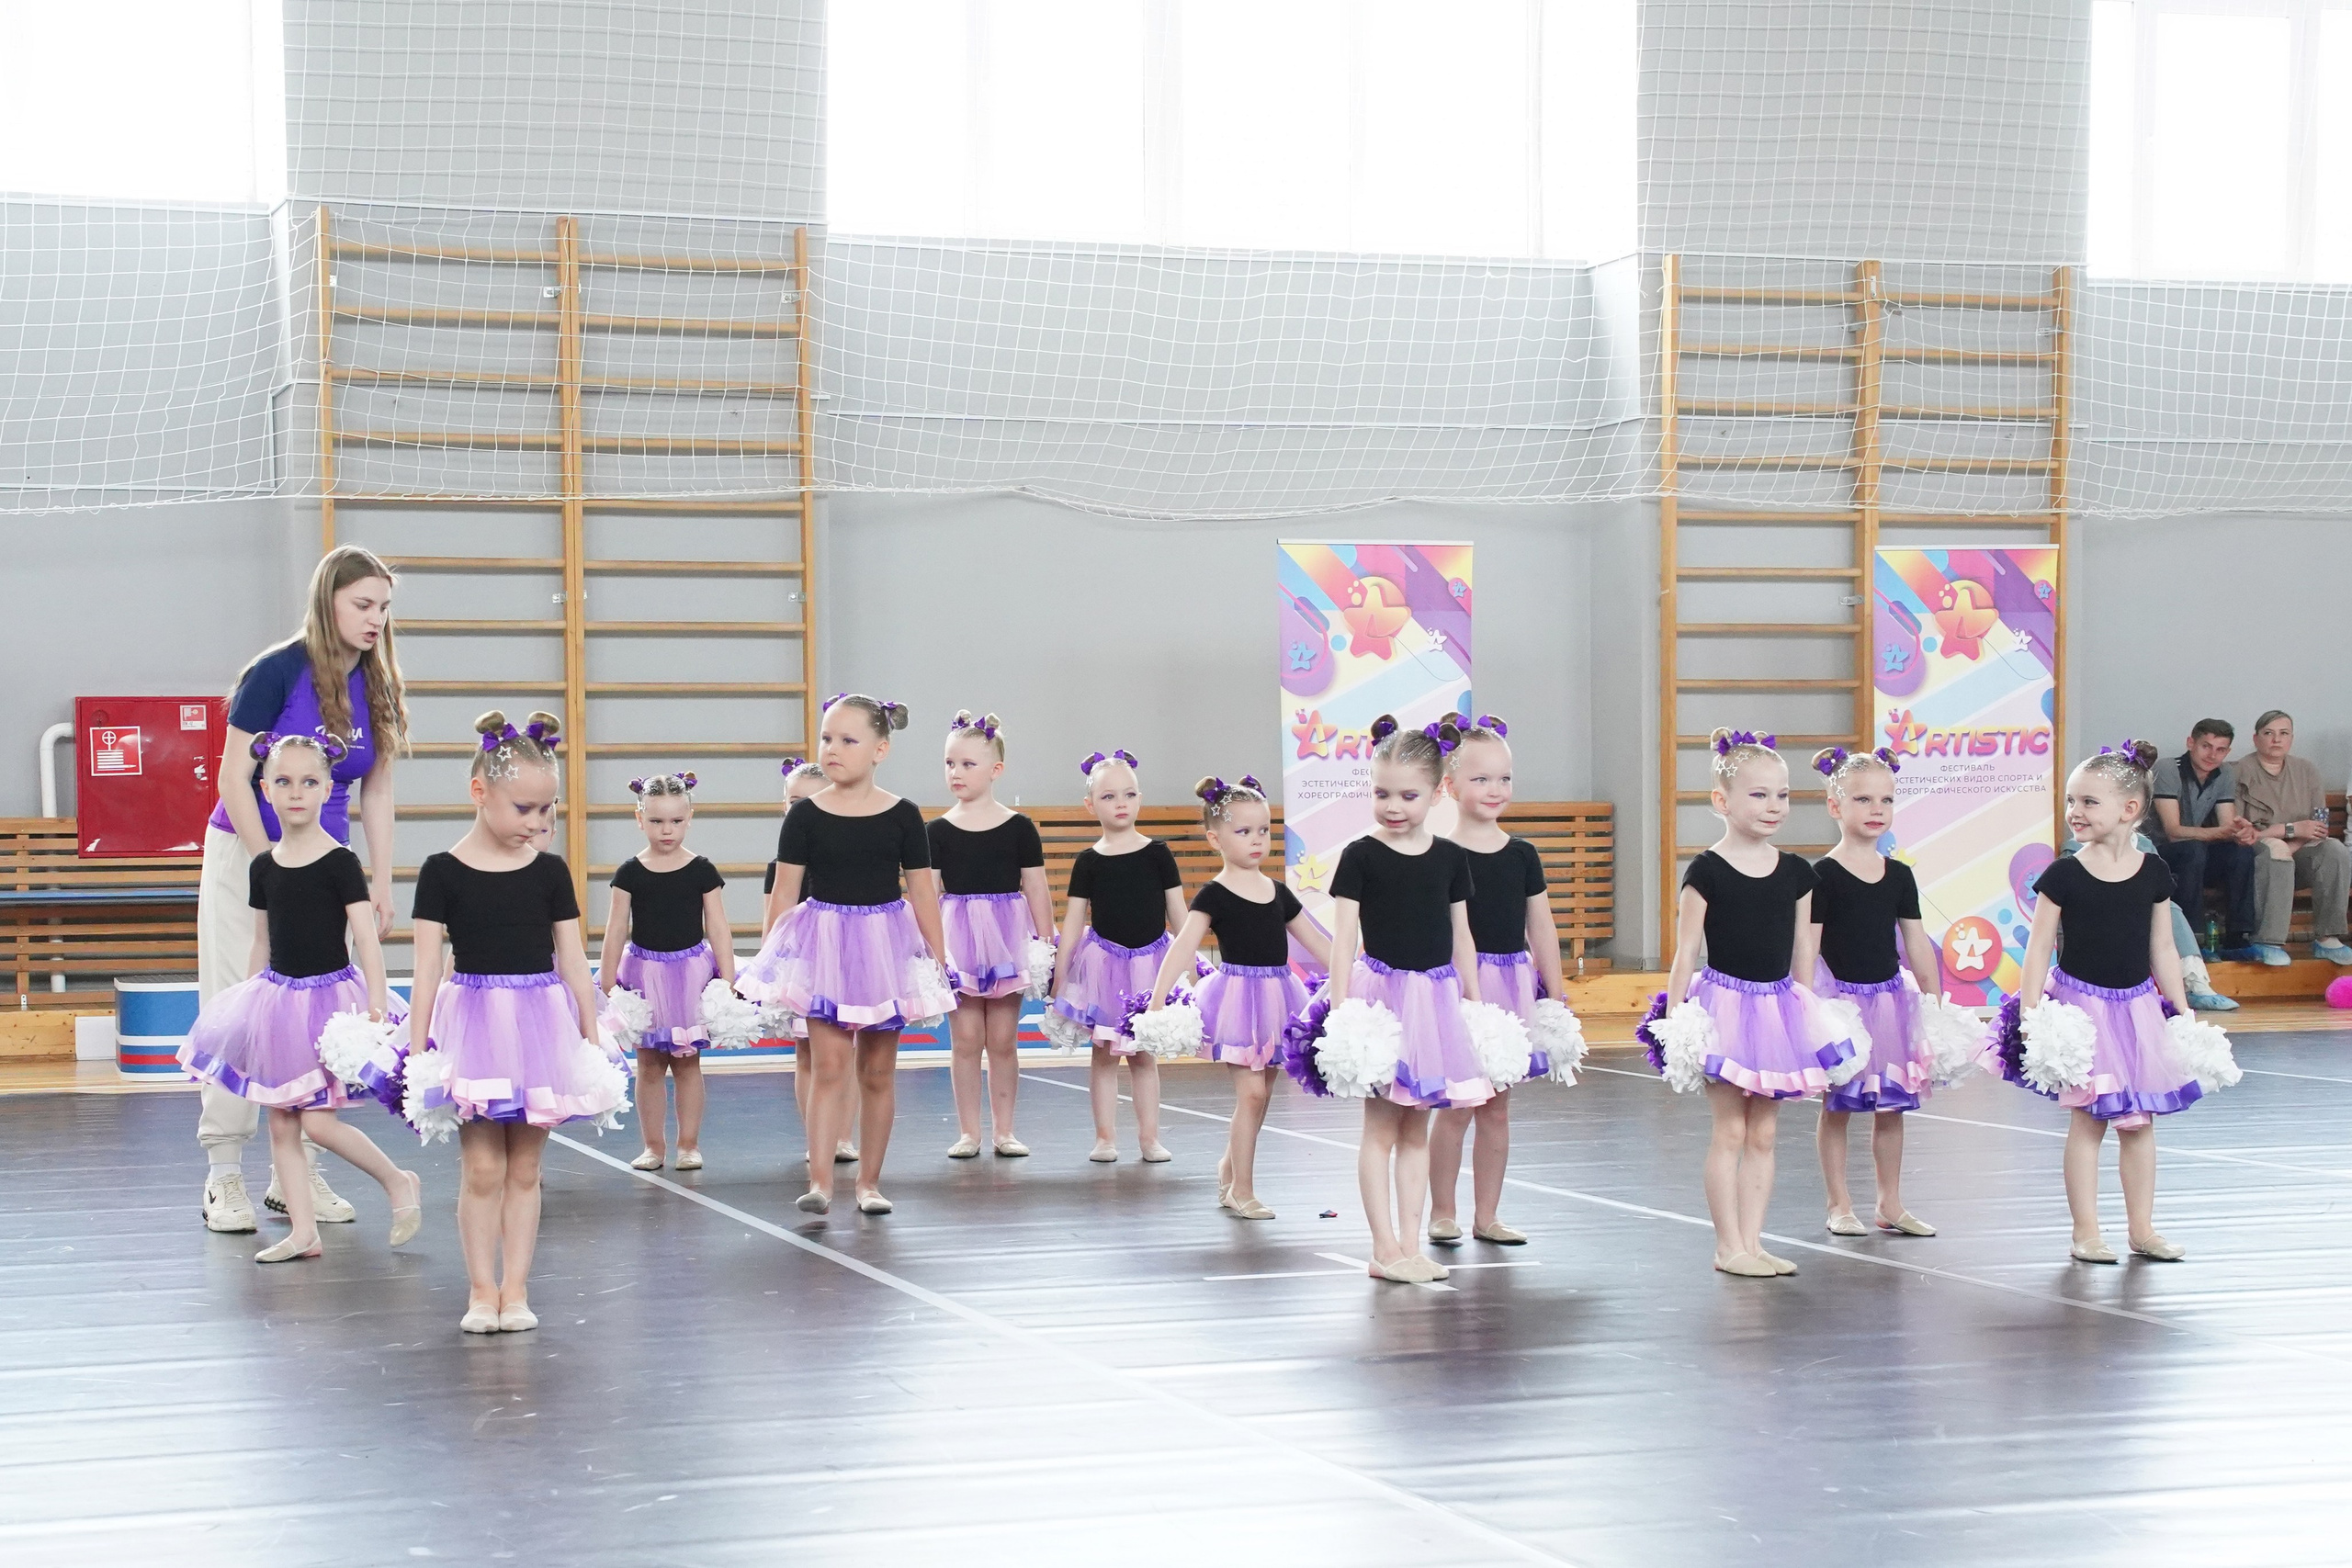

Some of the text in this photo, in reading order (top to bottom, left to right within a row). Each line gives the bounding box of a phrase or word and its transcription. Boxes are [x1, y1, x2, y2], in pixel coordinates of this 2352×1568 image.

[1884, 709, 2050, 756] ARTISTIC
[1939, 764, 1996, 773] ФЕСТИВАЛЬ
[1963, 774, 1996, 783] ВИДОВ
[1997, 774, 2034, 783] СПОРТА
[1894, 784, 2047, 795] ОРЕОГРАФИЧЕСКОГО ИСКУССТВА
